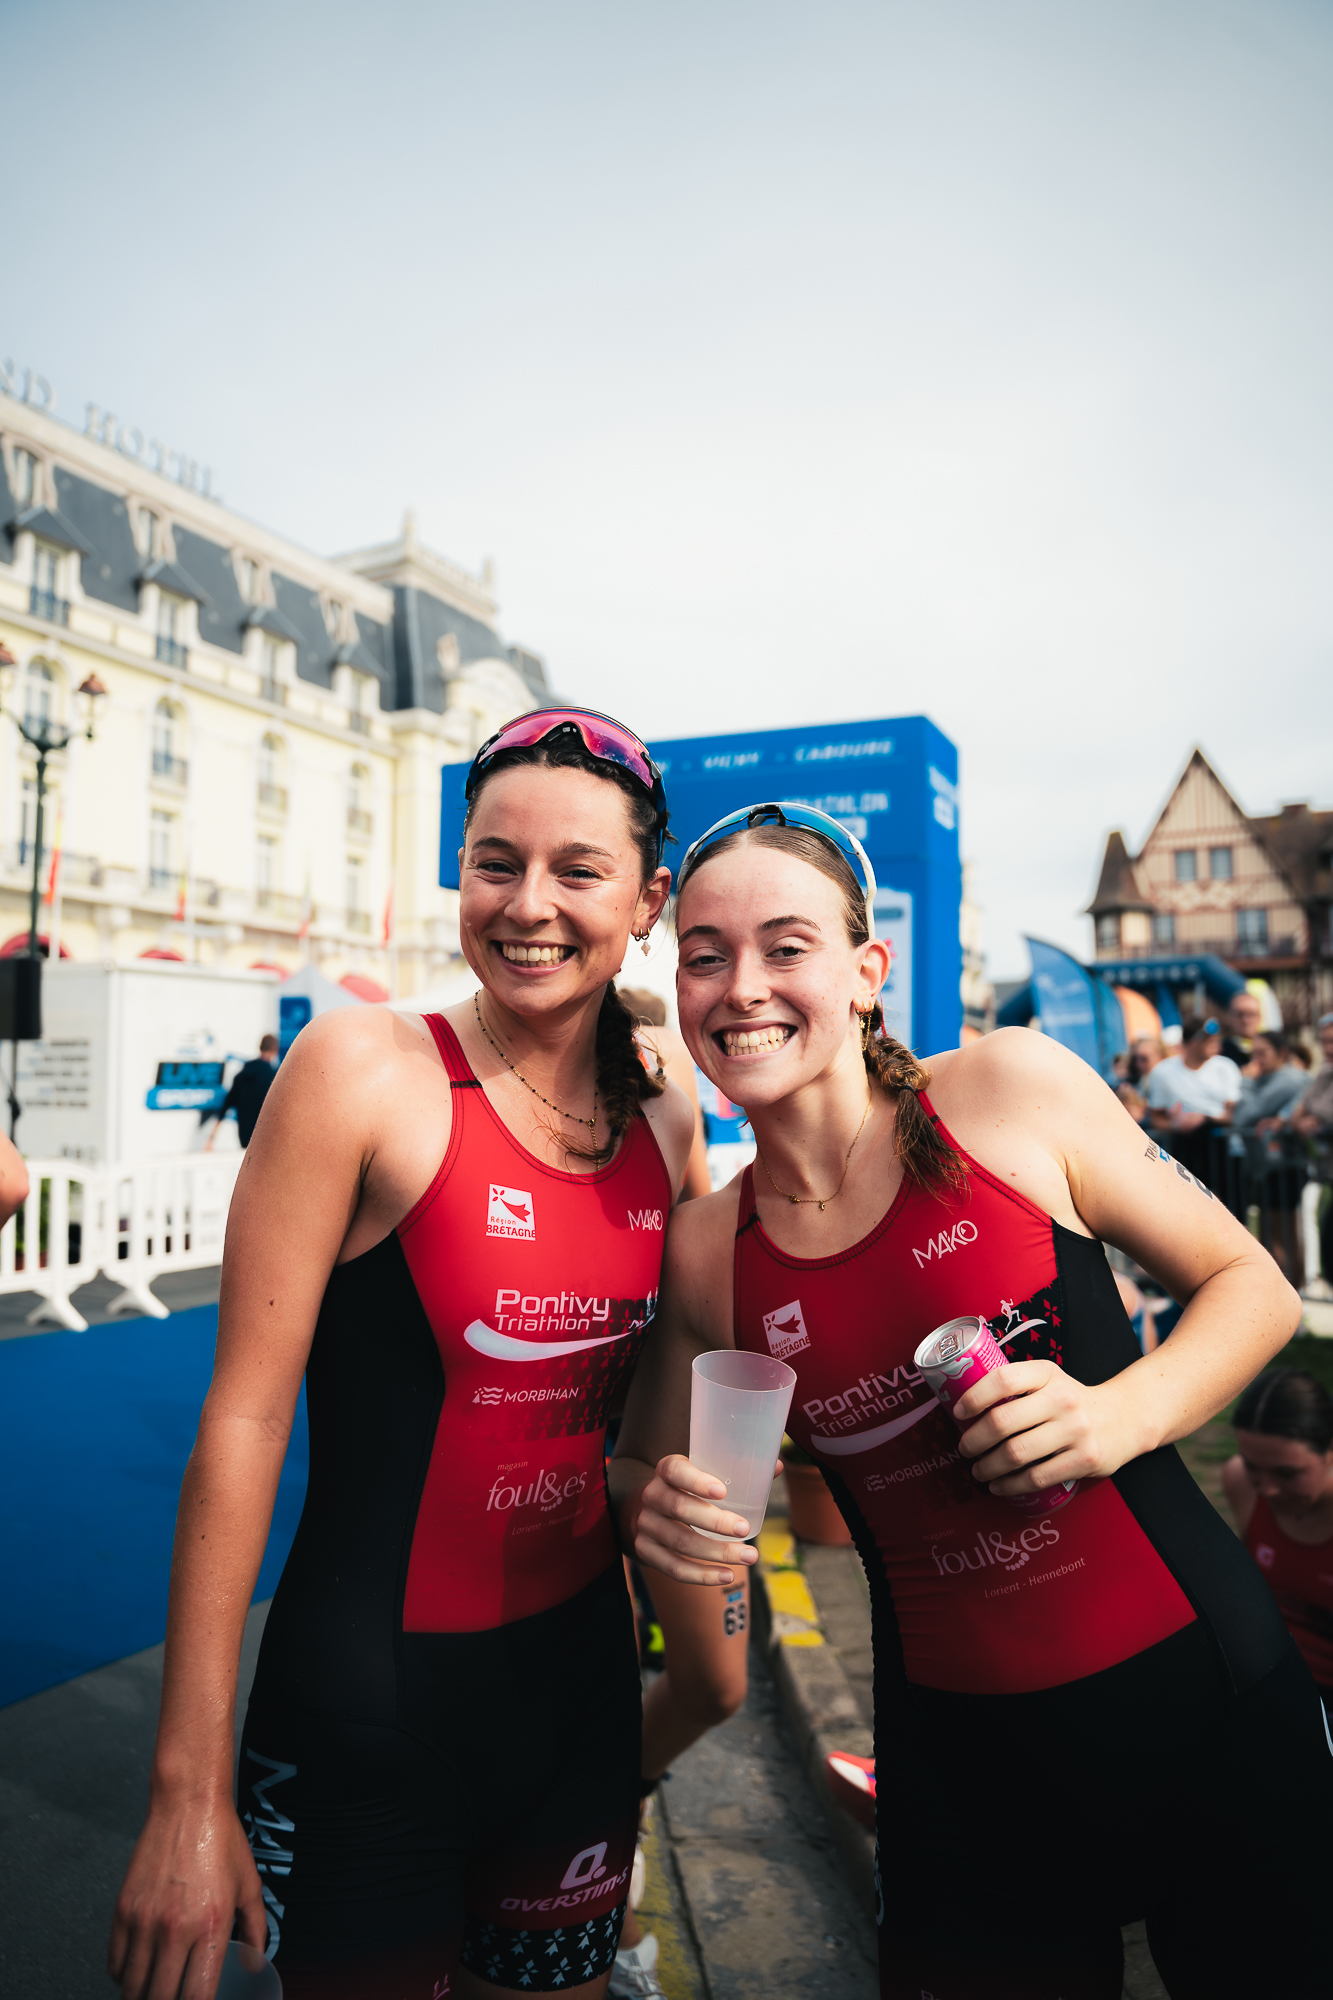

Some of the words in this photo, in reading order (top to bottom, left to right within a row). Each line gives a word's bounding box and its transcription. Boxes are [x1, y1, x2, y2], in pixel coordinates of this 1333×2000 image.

[486, 1224, 536, 1238] BRETAGNE
[627, 1209, 664, 1231] MAKO
[912, 1220, 978, 1268] MAKO
[495, 1289, 610, 1321] Pontivy
[494, 1314, 590, 1331] Triathlon
[504, 1387, 579, 1403] MORBIHAN
[802, 1365, 926, 1425] Pontivy
[816, 1388, 914, 1436] Triathlon
[497, 1460, 528, 1472] magasin
[884, 1449, 962, 1485] MORBIHAN
[486, 1469, 587, 1511] foul&es
[511, 1521, 542, 1536] Lorient
[922, 1528, 955, 1542] magasin
[931, 1519, 1060, 1576] foul&es
[984, 1581, 1020, 1599] Lorient
[1028, 1556, 1086, 1587] Hennebont
